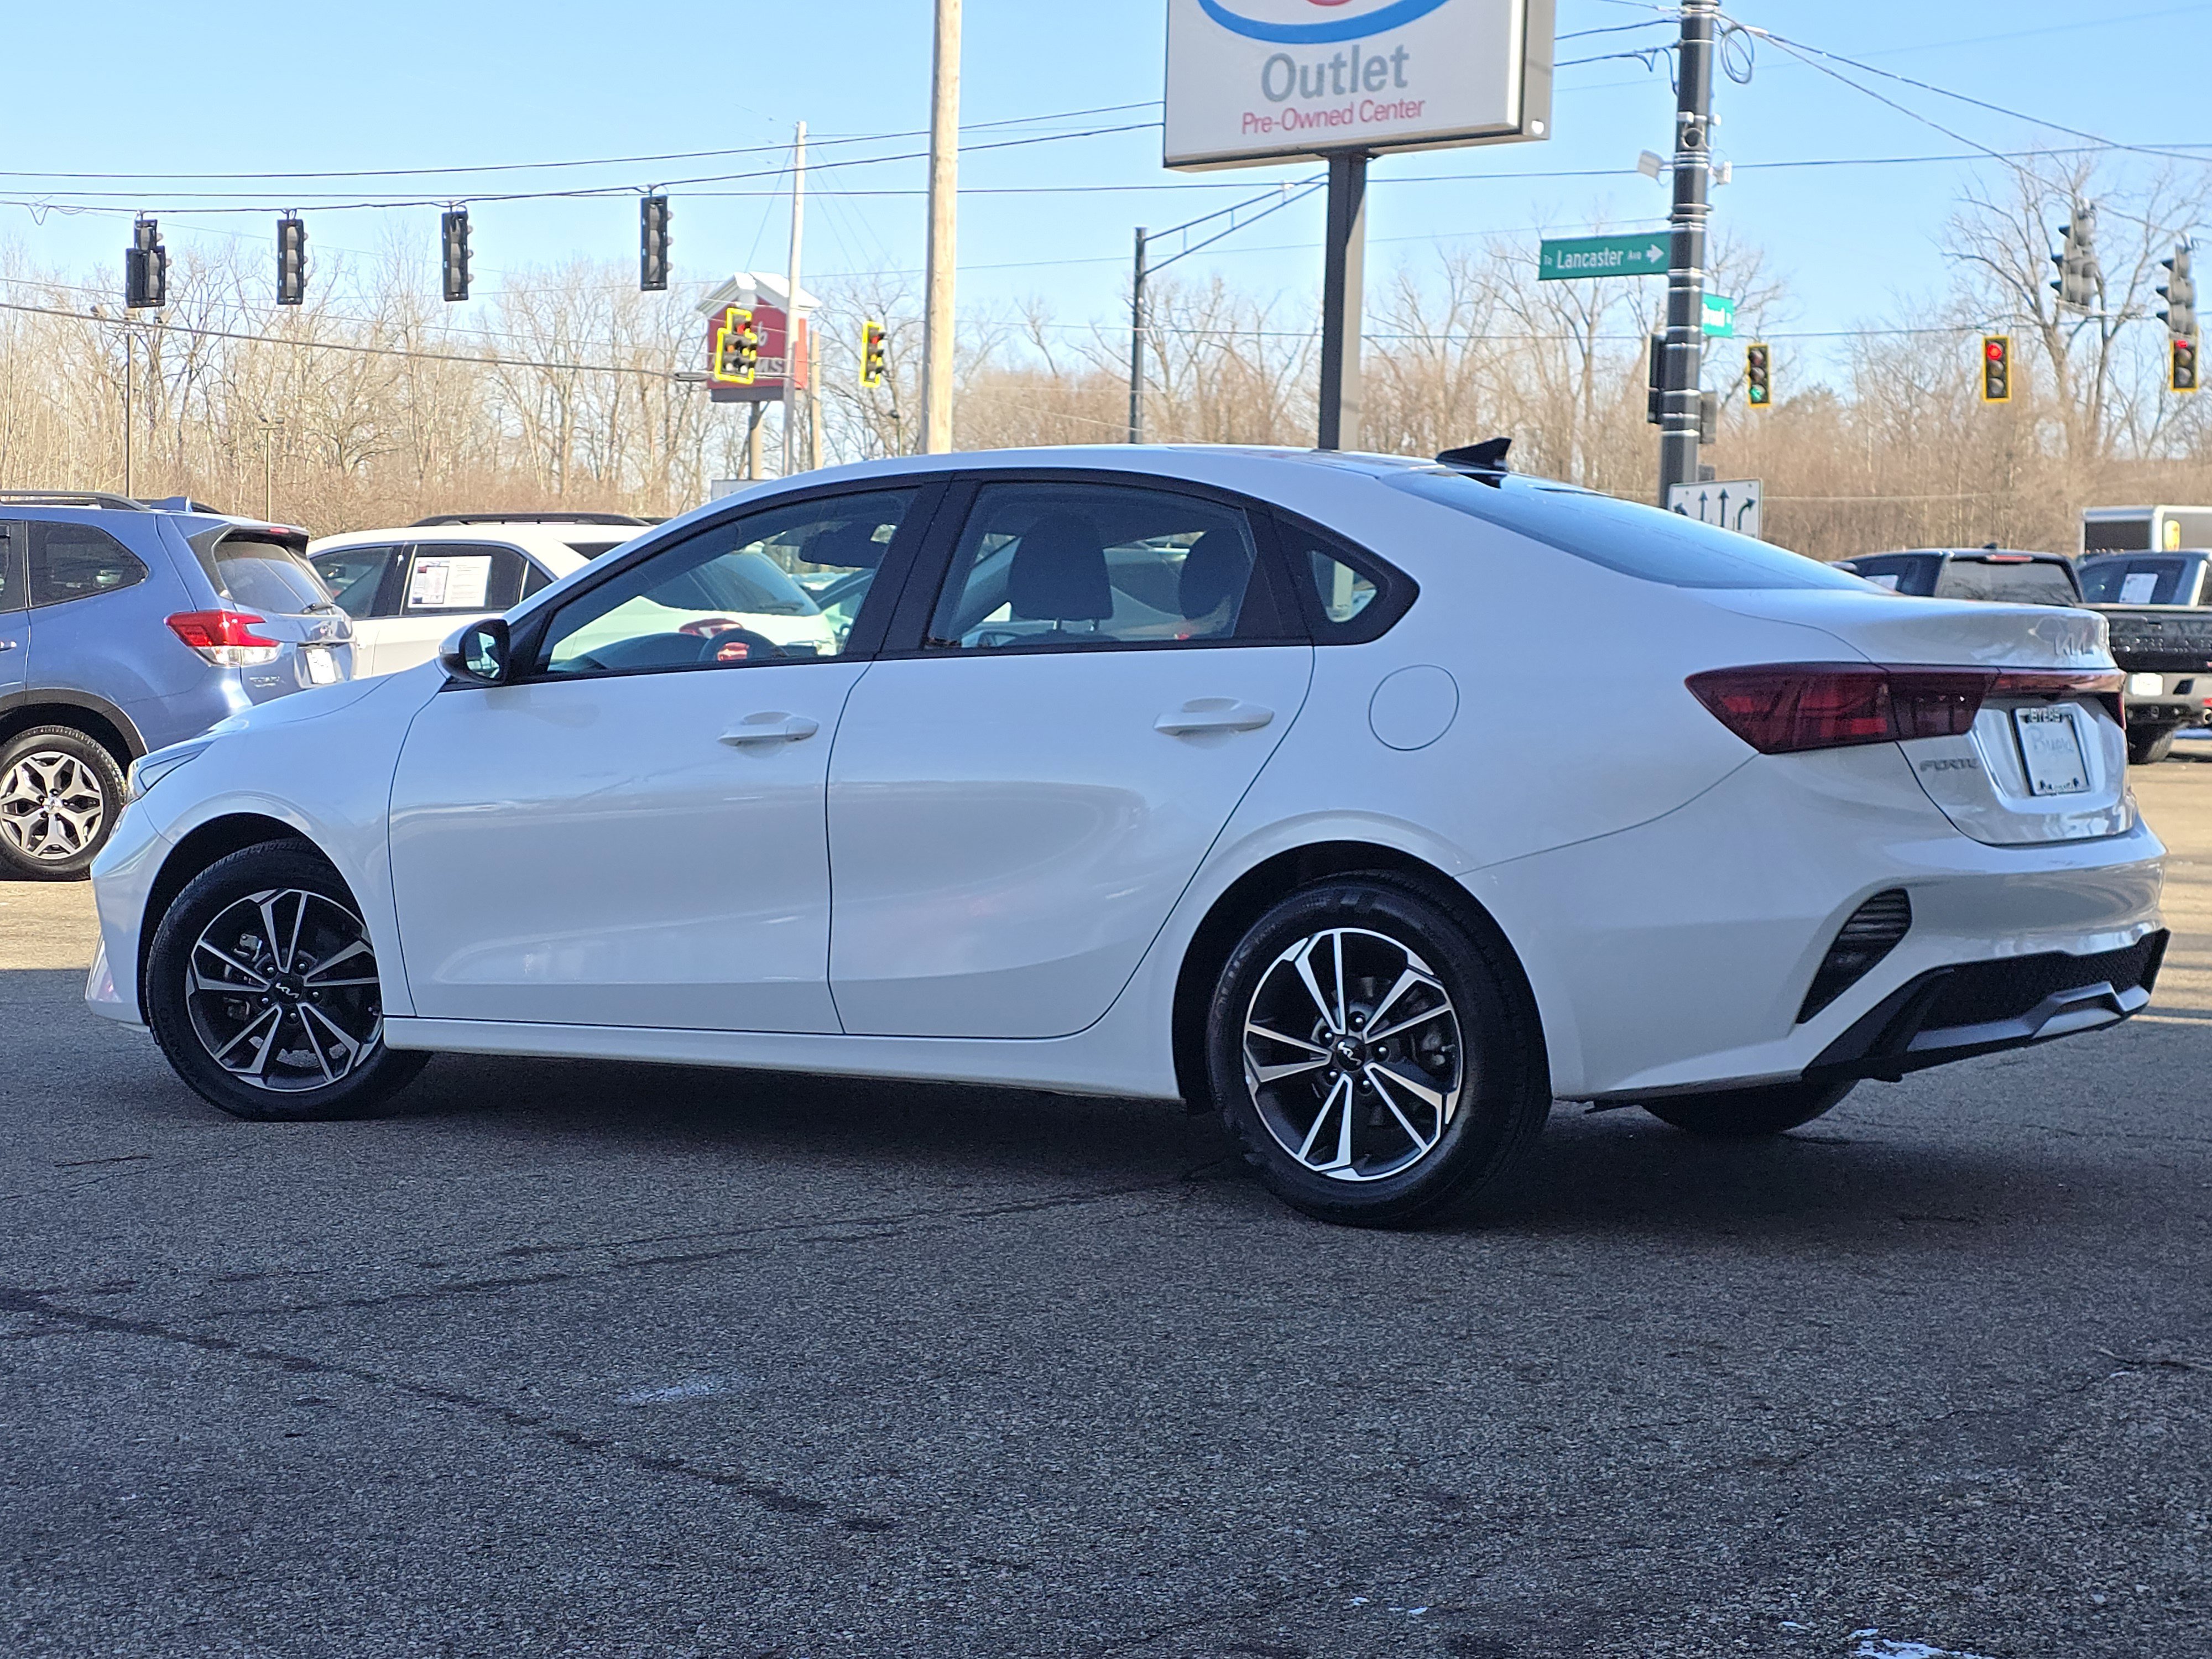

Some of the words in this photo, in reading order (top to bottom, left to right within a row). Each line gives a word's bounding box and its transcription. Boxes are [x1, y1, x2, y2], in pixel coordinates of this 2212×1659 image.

[1261, 44, 1410, 102] Outlet
[1243, 101, 1354, 135] Pre-Owned
[1359, 98, 1426, 123] Center
[1557, 247, 1624, 269] Lancaster
